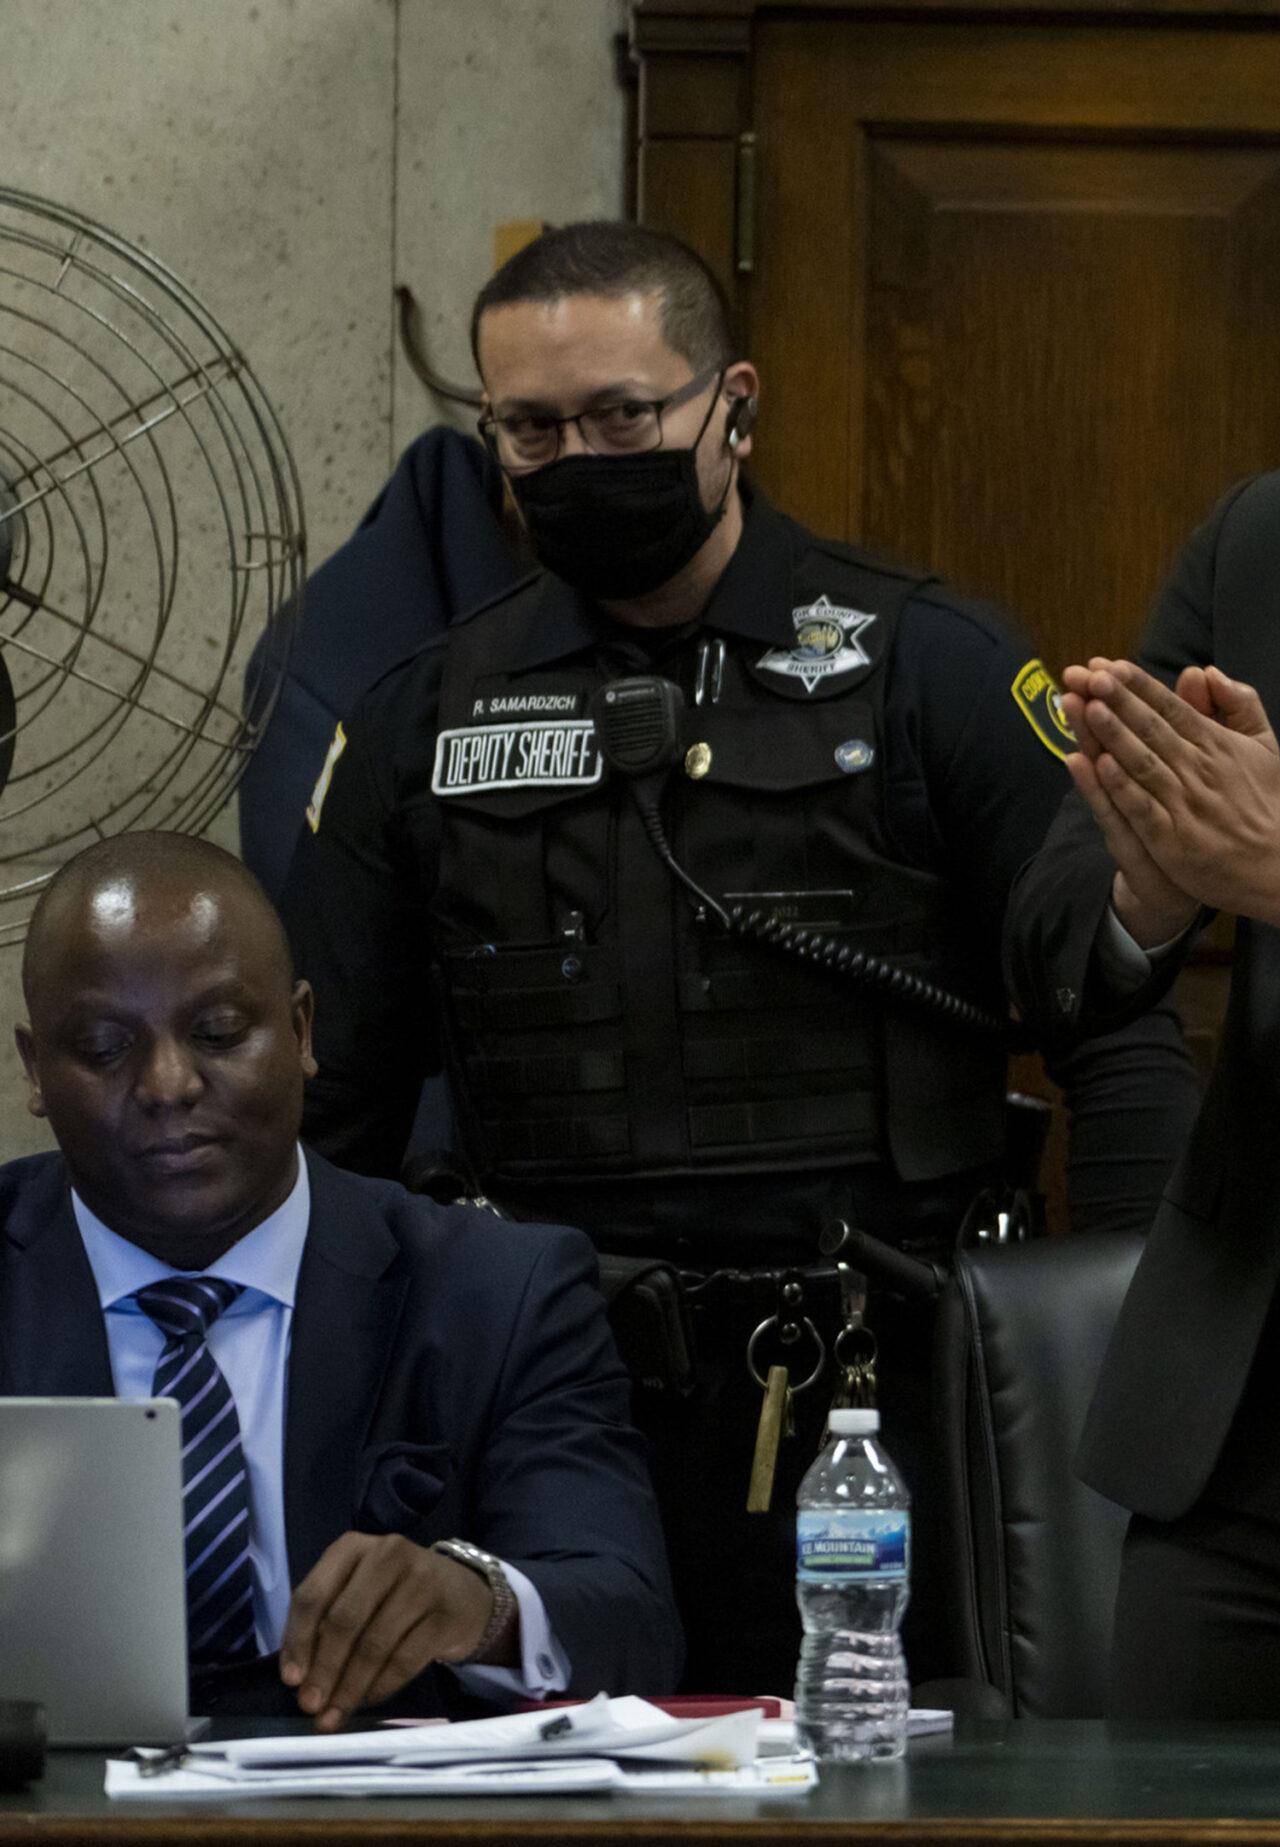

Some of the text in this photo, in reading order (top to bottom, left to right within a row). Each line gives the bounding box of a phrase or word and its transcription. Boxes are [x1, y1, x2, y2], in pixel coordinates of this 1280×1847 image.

[787, 662, 835, 675] SHERIFF
[489, 695, 576, 713] SAMARDZICH
[446, 729, 595, 786] DEPUTY SHERIFF
[814, 1541, 875, 1555] MOUNTAIN
